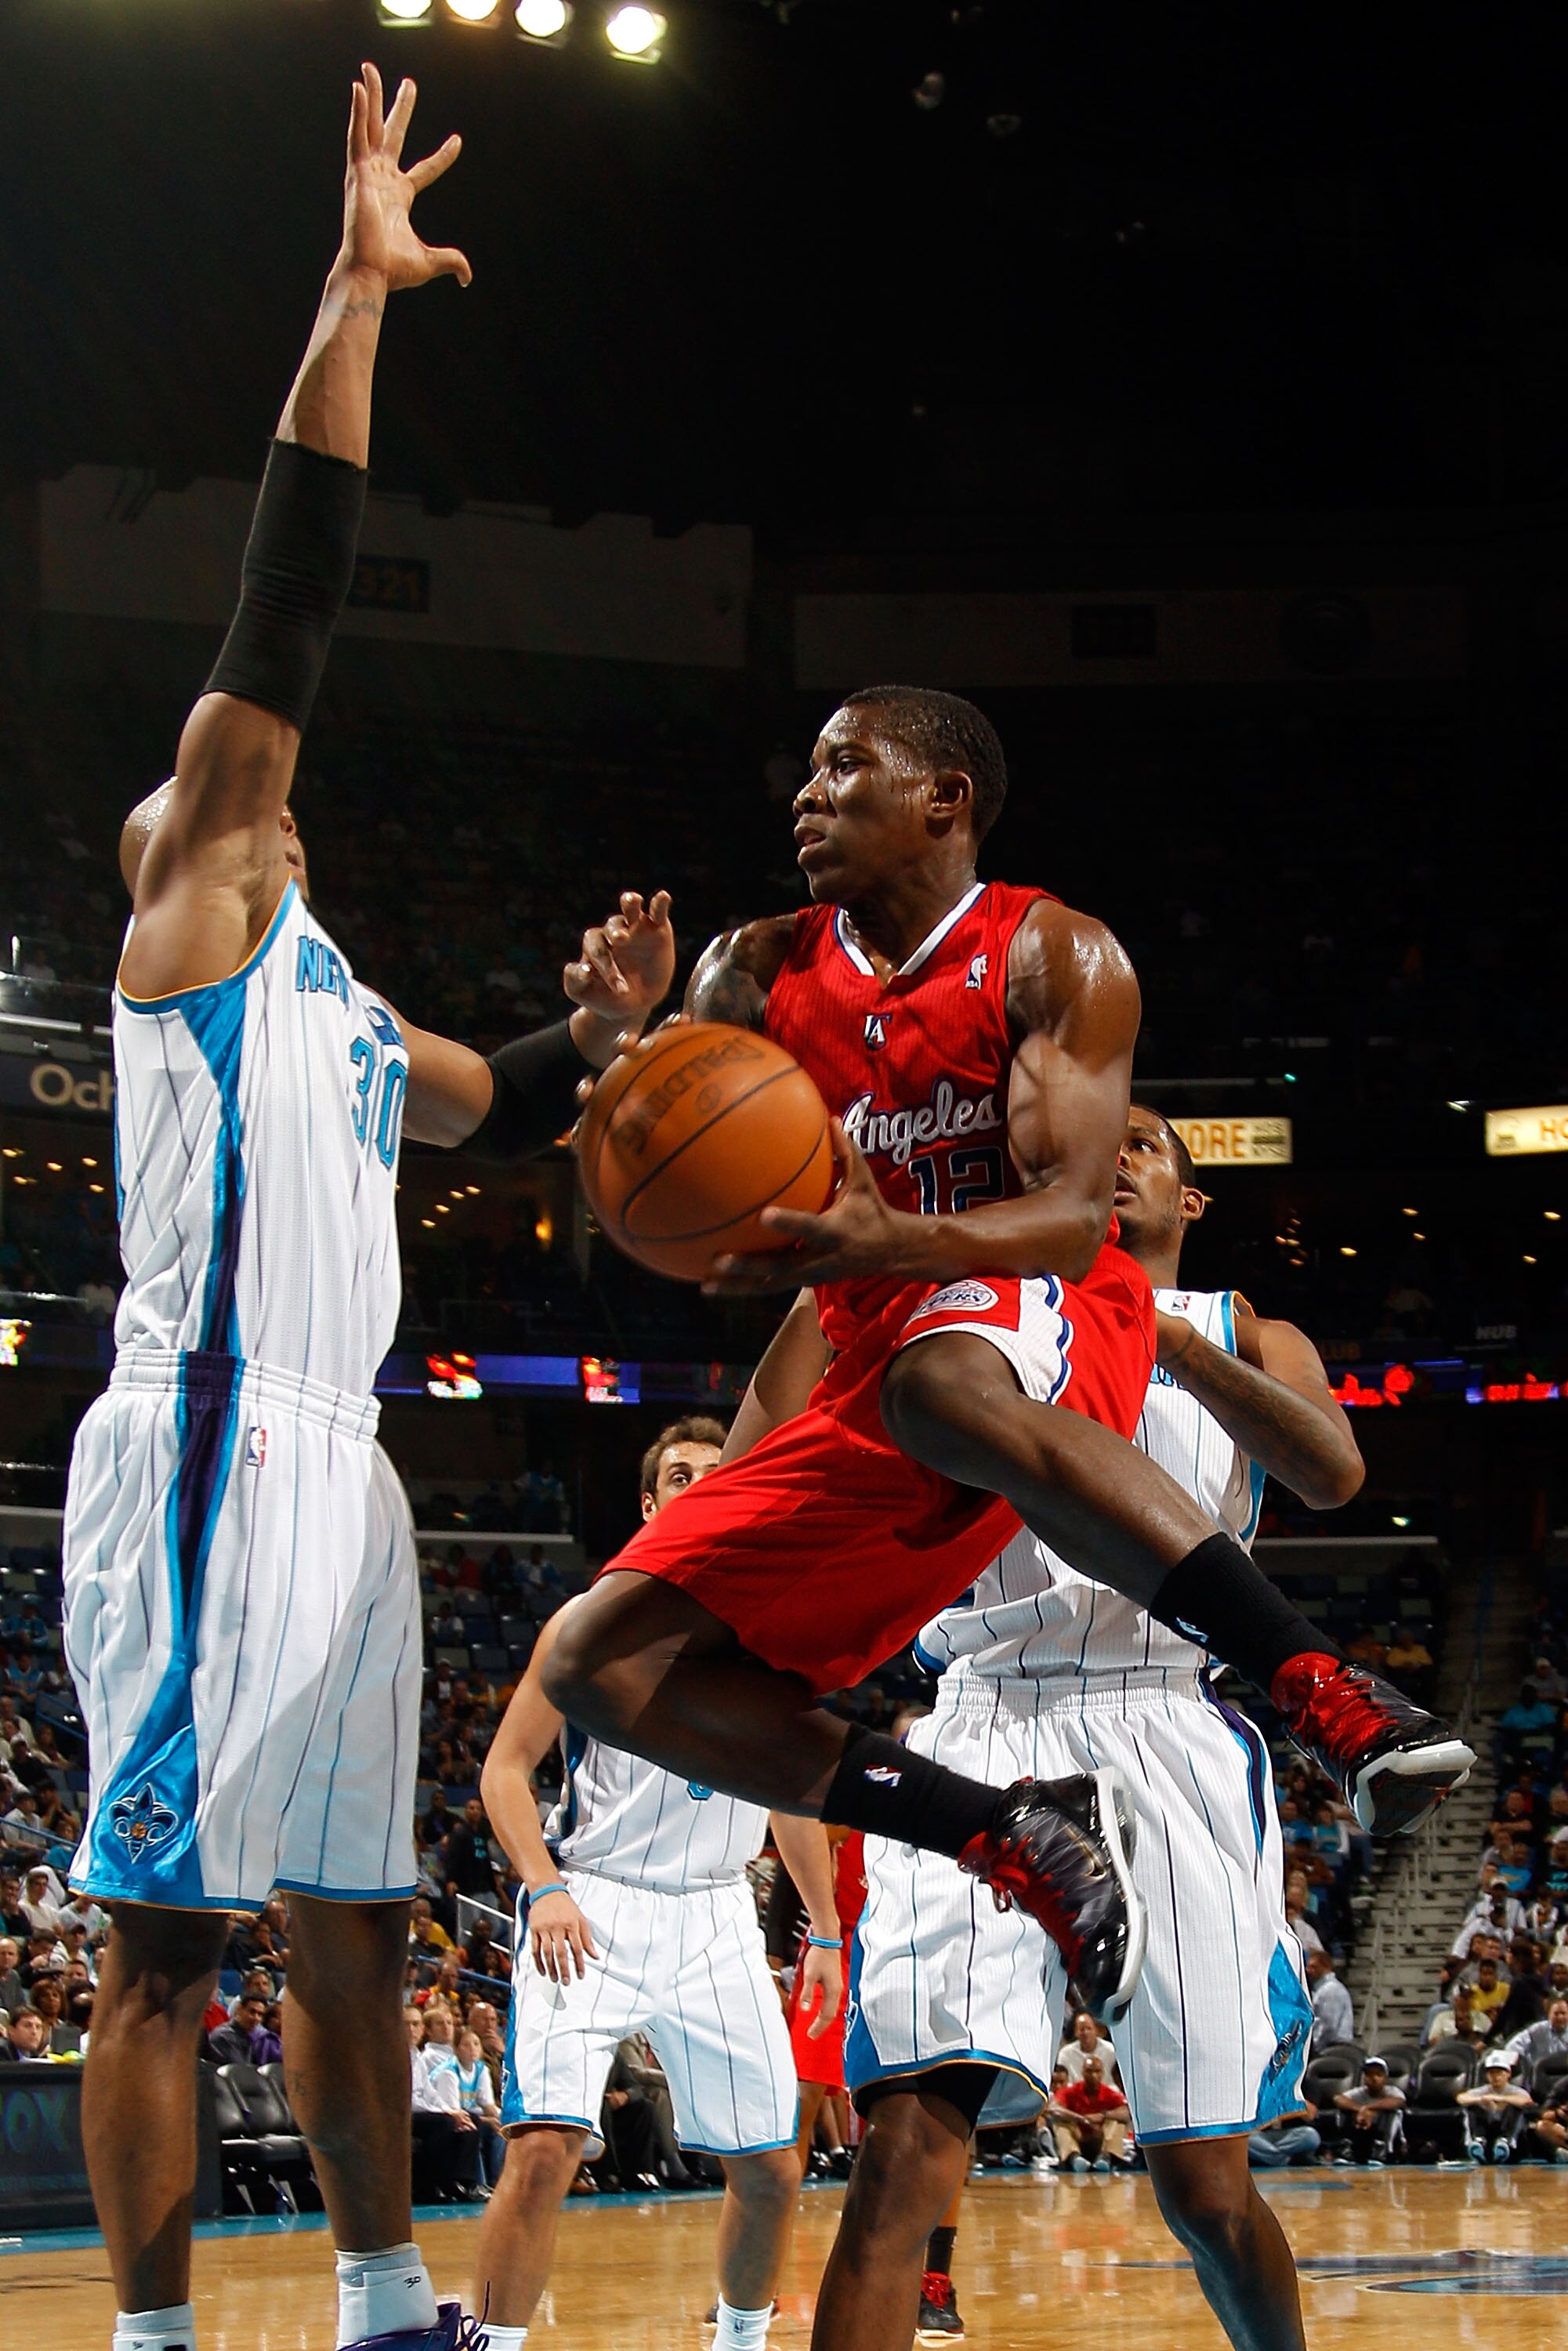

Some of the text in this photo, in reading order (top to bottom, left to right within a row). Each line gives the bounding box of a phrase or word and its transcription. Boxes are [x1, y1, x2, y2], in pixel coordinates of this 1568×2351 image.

[349, 1036, 407, 1171] 30
[843, 1080, 1003, 1165] Angeles
[907, 1147, 1005, 1215] 12
[0, 2089, 73, 2154] OX
